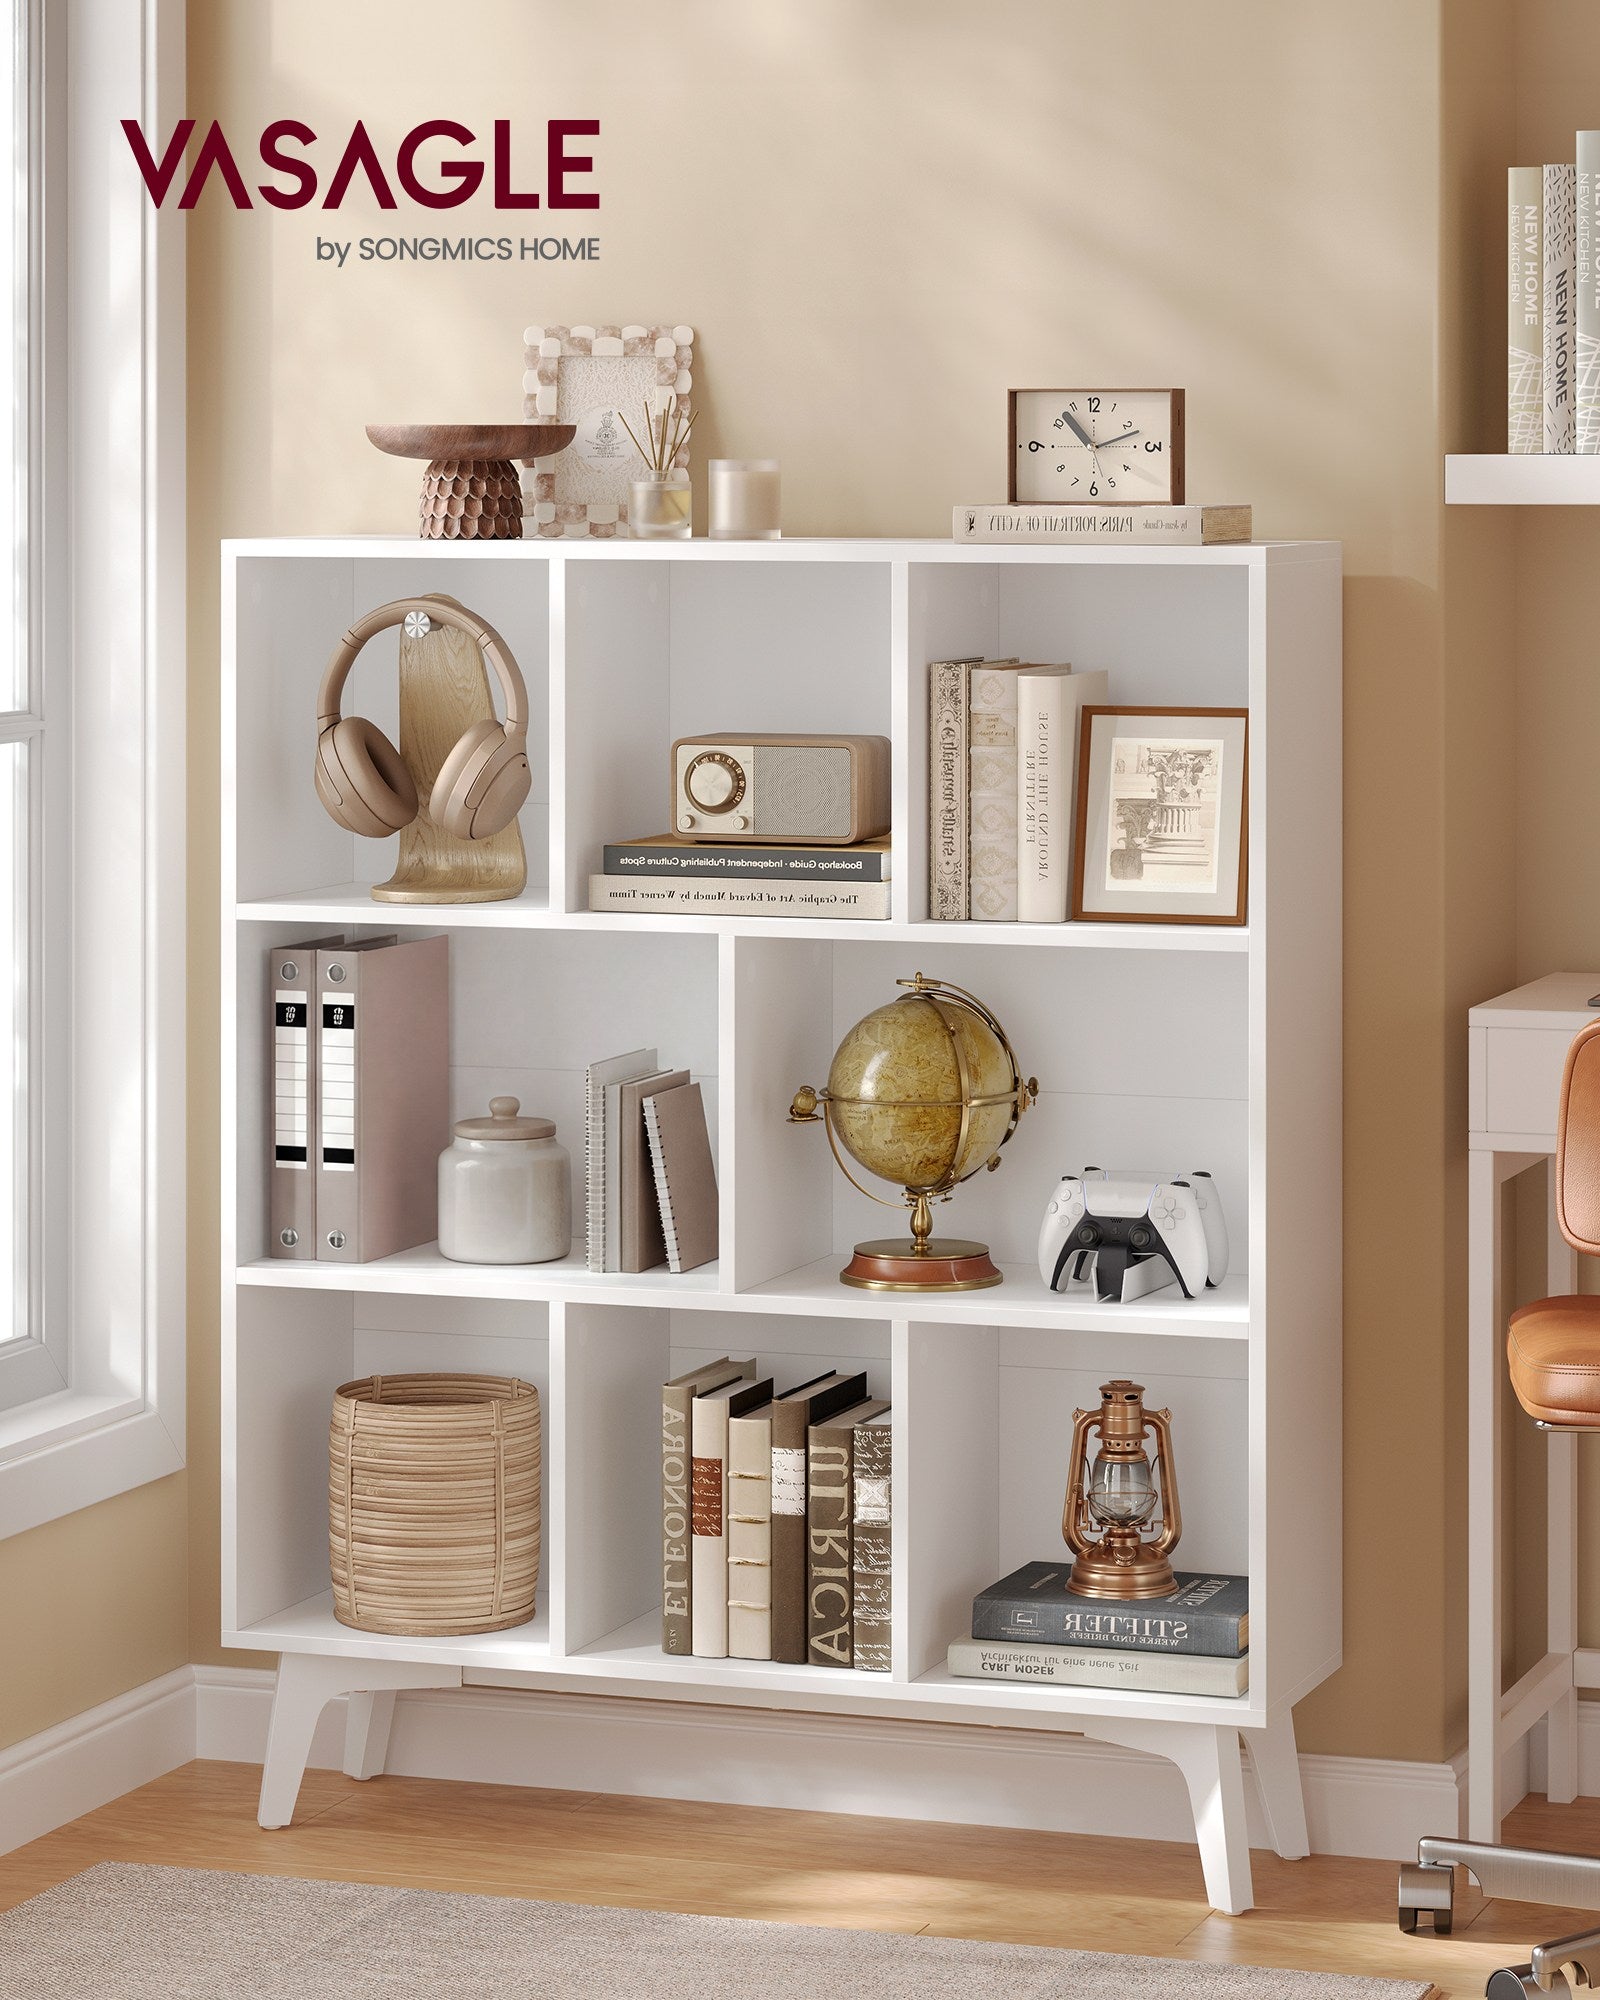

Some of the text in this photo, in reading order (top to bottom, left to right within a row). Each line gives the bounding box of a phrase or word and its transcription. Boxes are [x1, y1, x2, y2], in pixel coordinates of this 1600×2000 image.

[1579, 173, 1590, 283] NEW KITCHEN
[1511, 205, 1520, 303] NEW KITCHEN
[1524, 205, 1538, 326] NEW HOME
[1555, 268, 1568, 408] NEW HOME
[1069, 401, 1078, 412] 11
[1087, 397, 1101, 413] 12
[1111, 403, 1117, 412] 1
[1053, 418, 1064, 430] 10
[1122, 420, 1133, 430] 2
[1144, 441, 1162, 453] 3
[1056, 464, 1065, 473] 8
[1122, 463, 1131, 472] 4
[1070, 477, 1080, 487] 7
[1107, 477, 1116, 488] 5
[1089, 481, 1098, 497] 6
